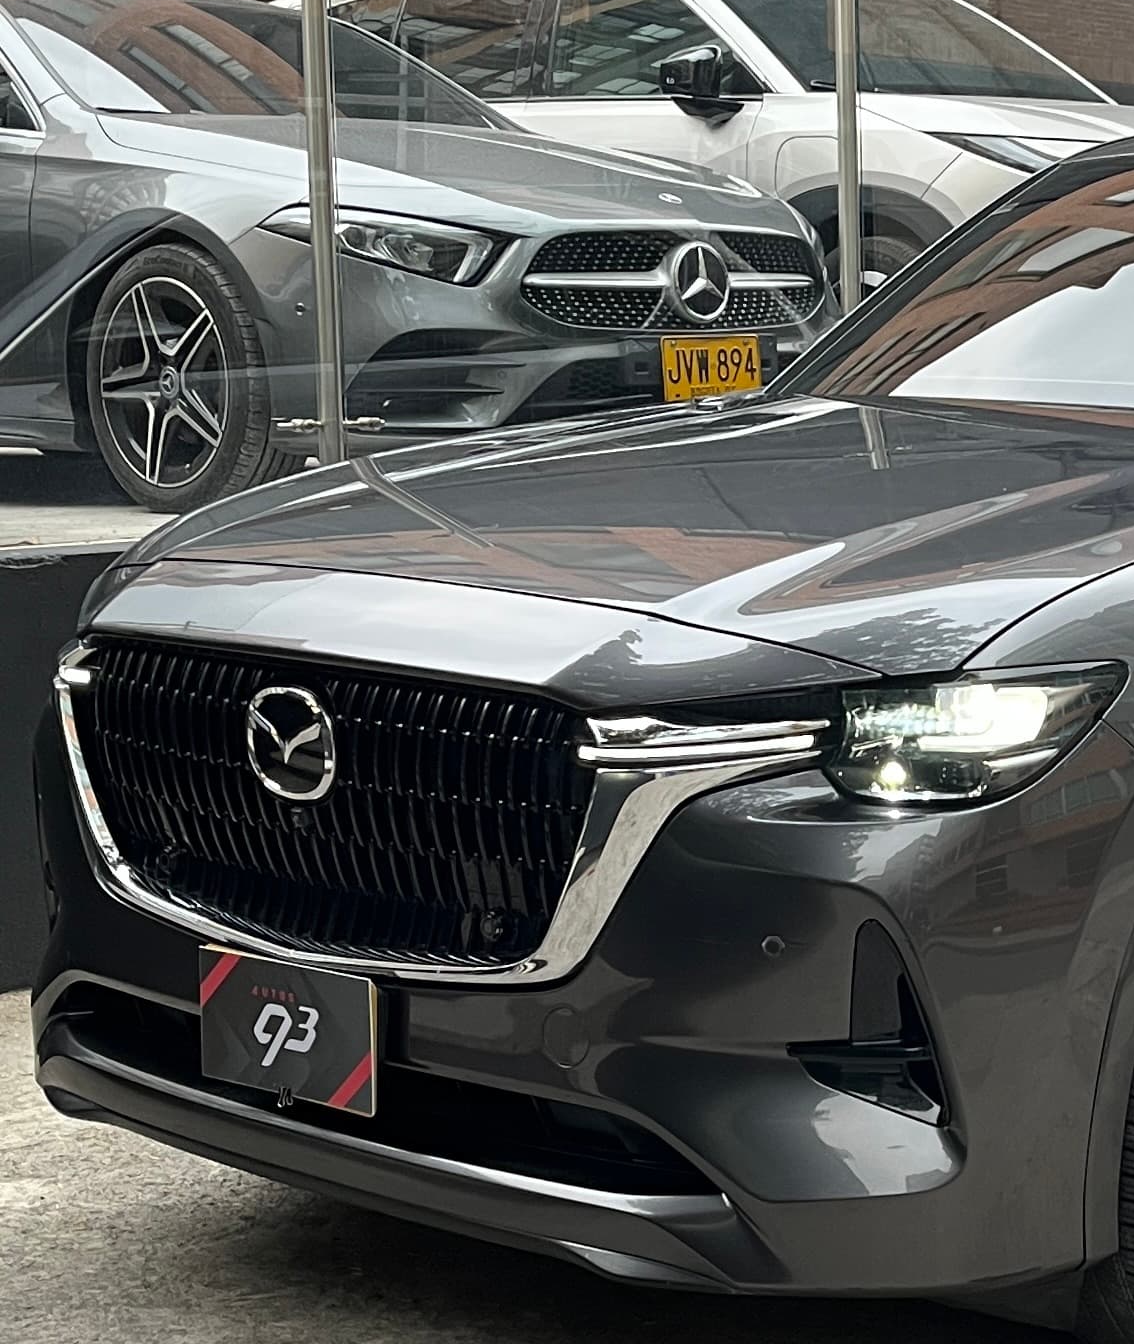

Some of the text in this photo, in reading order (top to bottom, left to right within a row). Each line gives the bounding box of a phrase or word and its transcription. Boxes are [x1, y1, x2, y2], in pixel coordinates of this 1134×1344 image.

[668, 347, 757, 385] JVW 894
[253, 1002, 320, 1067] 93
